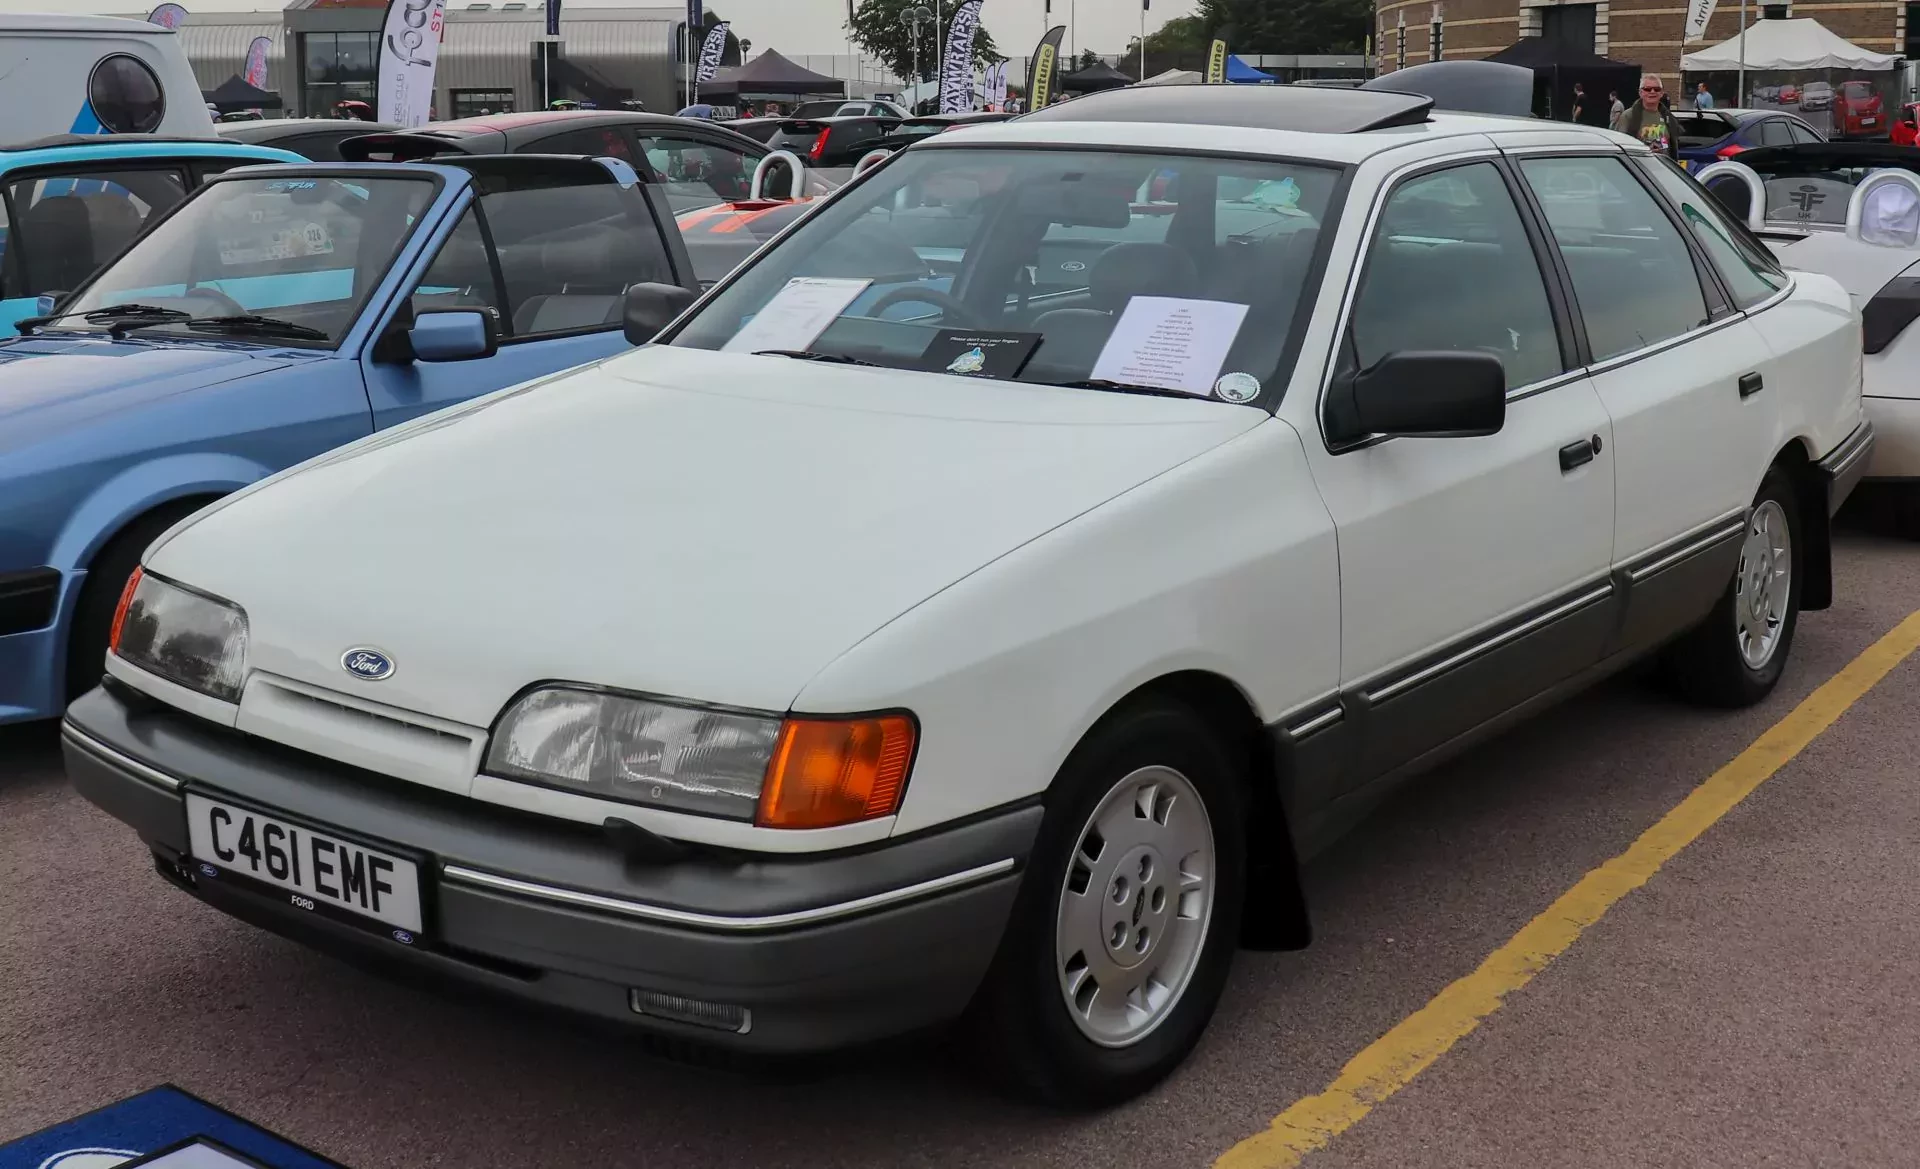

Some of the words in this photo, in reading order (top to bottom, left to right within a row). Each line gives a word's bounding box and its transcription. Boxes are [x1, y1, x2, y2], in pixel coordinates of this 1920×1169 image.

[351, 653, 382, 673] Ford
[210, 806, 301, 887] C461
[311, 837, 394, 913] EMF
[291, 895, 314, 911] FORD
